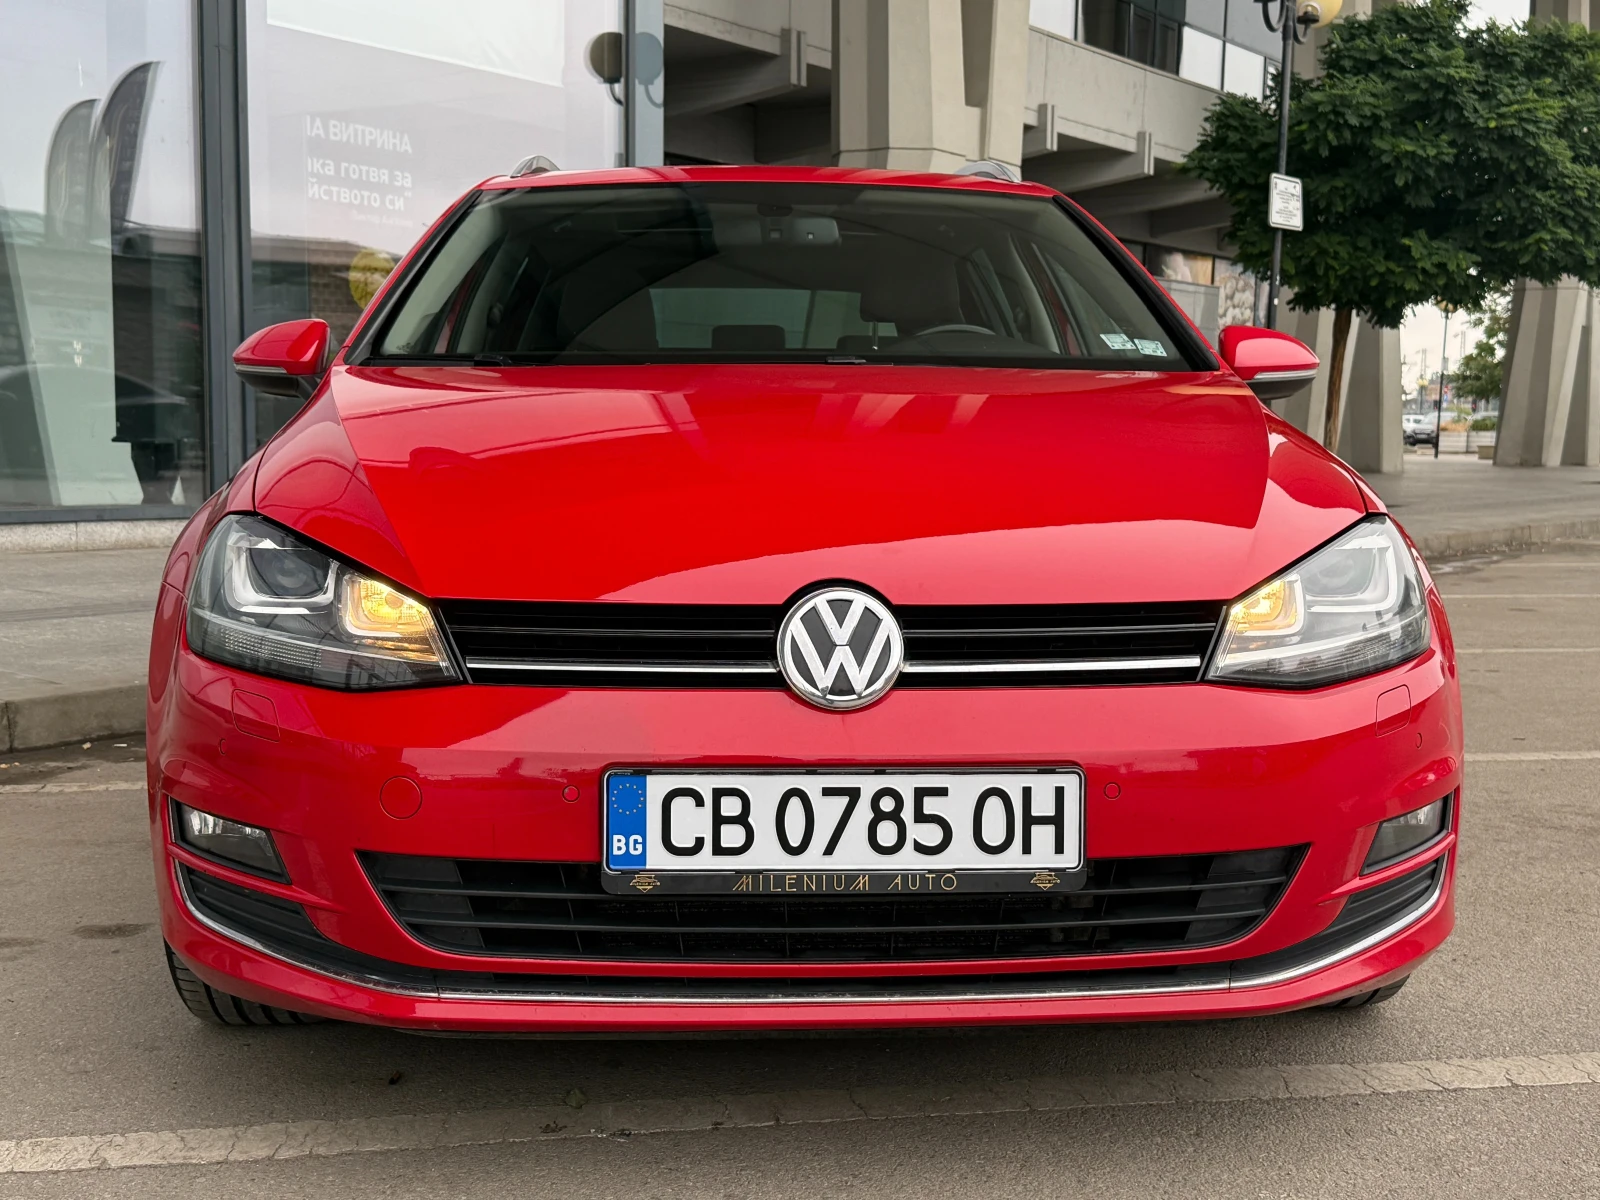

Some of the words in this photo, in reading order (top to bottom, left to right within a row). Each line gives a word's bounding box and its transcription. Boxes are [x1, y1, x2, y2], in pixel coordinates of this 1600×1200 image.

[328, 119, 412, 154] ВИТРИНА
[340, 162, 389, 185] готвя
[393, 170, 412, 188] за
[661, 787, 755, 857] CB
[775, 786, 953, 857] 0785
[612, 834, 643, 856] BG
[732, 874, 869, 893] MILENIUM
[887, 873, 957, 892] AUTO
